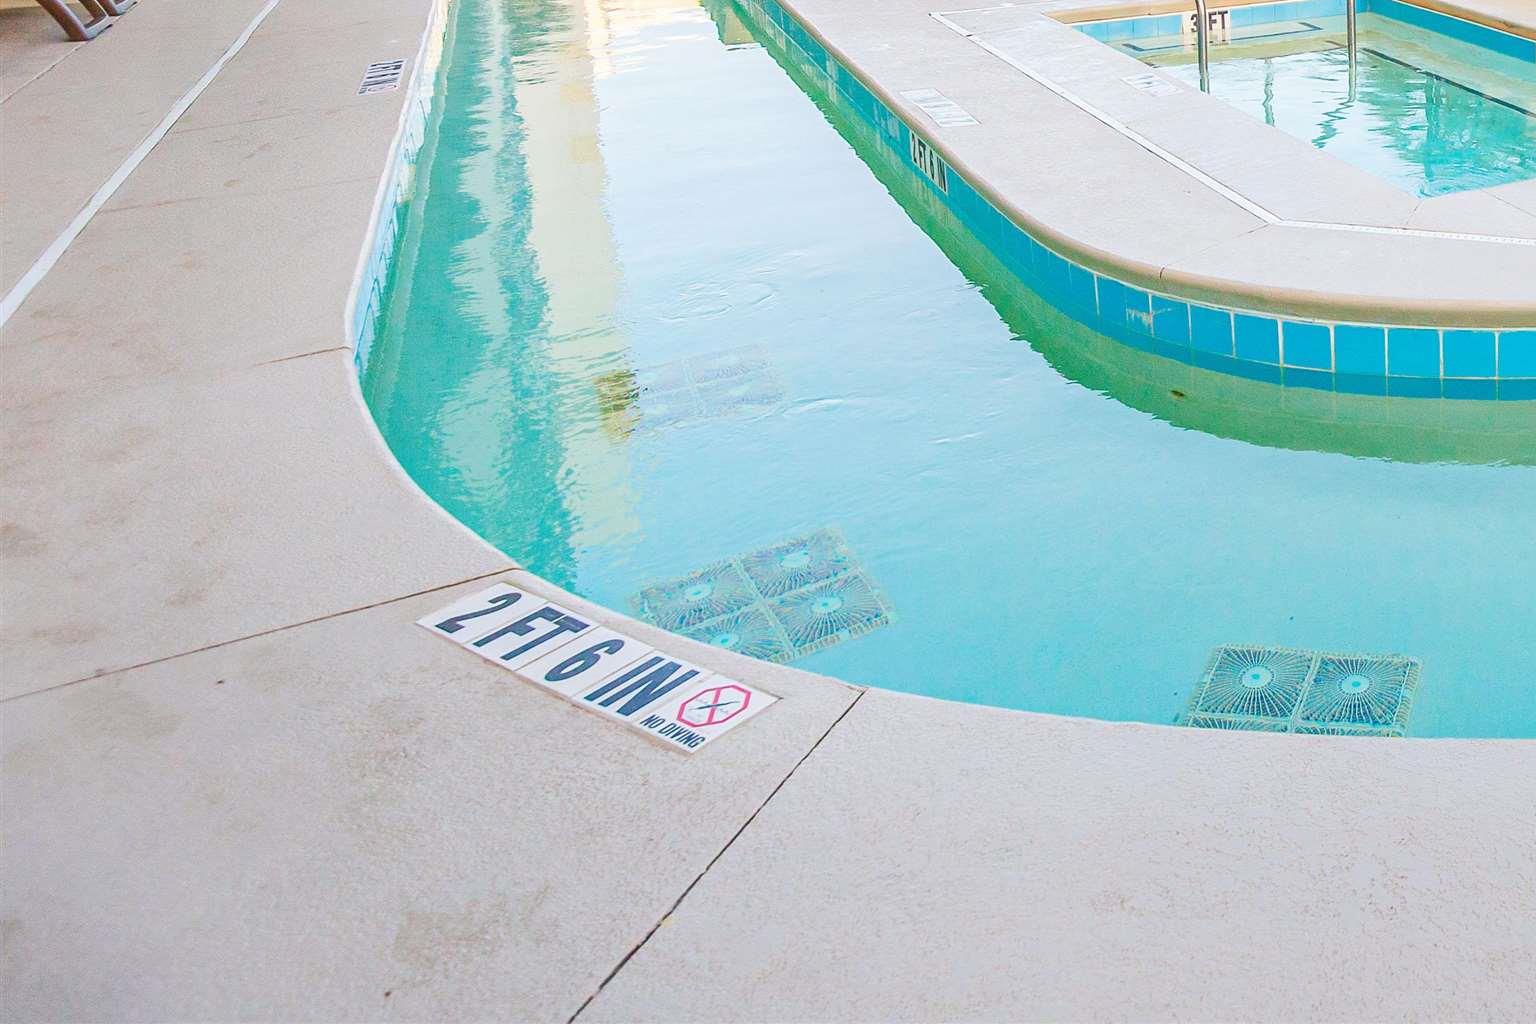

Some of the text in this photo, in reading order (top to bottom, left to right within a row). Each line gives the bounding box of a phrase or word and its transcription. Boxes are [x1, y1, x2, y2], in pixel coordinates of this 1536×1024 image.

[1190, 10, 1228, 33] 3 FT
[917, 137, 927, 174] FT
[434, 592, 700, 716] 2 FT 6 IN
[639, 714, 706, 748] NO DIVING
